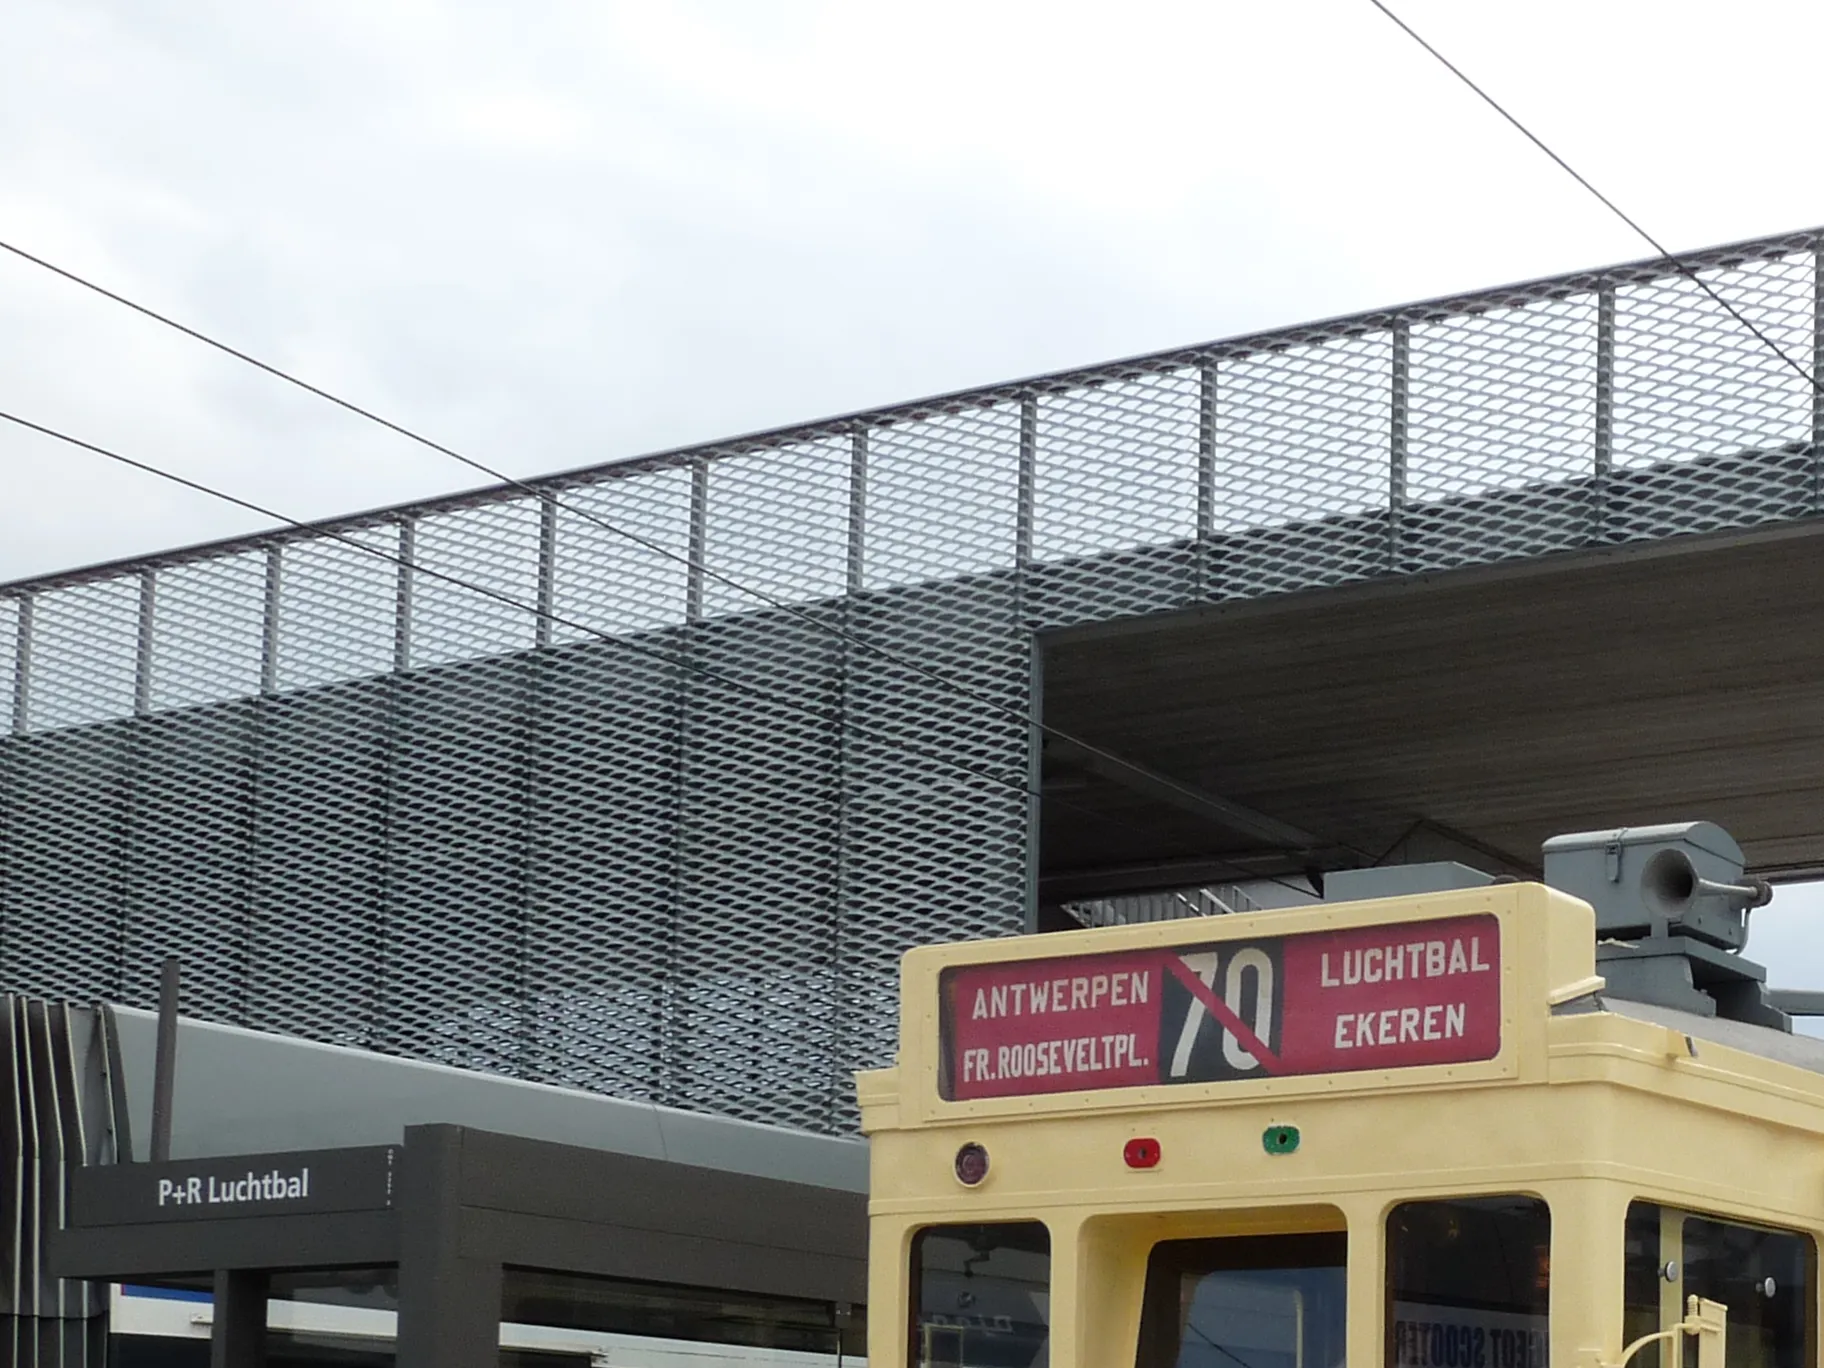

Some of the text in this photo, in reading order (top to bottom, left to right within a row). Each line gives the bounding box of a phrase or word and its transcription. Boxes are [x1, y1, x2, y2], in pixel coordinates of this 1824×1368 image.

[1321, 937, 1490, 987] LUCHTBAL
[972, 971, 1149, 1020] ANTWERPEN
[1170, 948, 1273, 1077] 70
[1334, 1002, 1466, 1049] EKEREN
[158, 1168, 309, 1206] P+R Luchtbal
